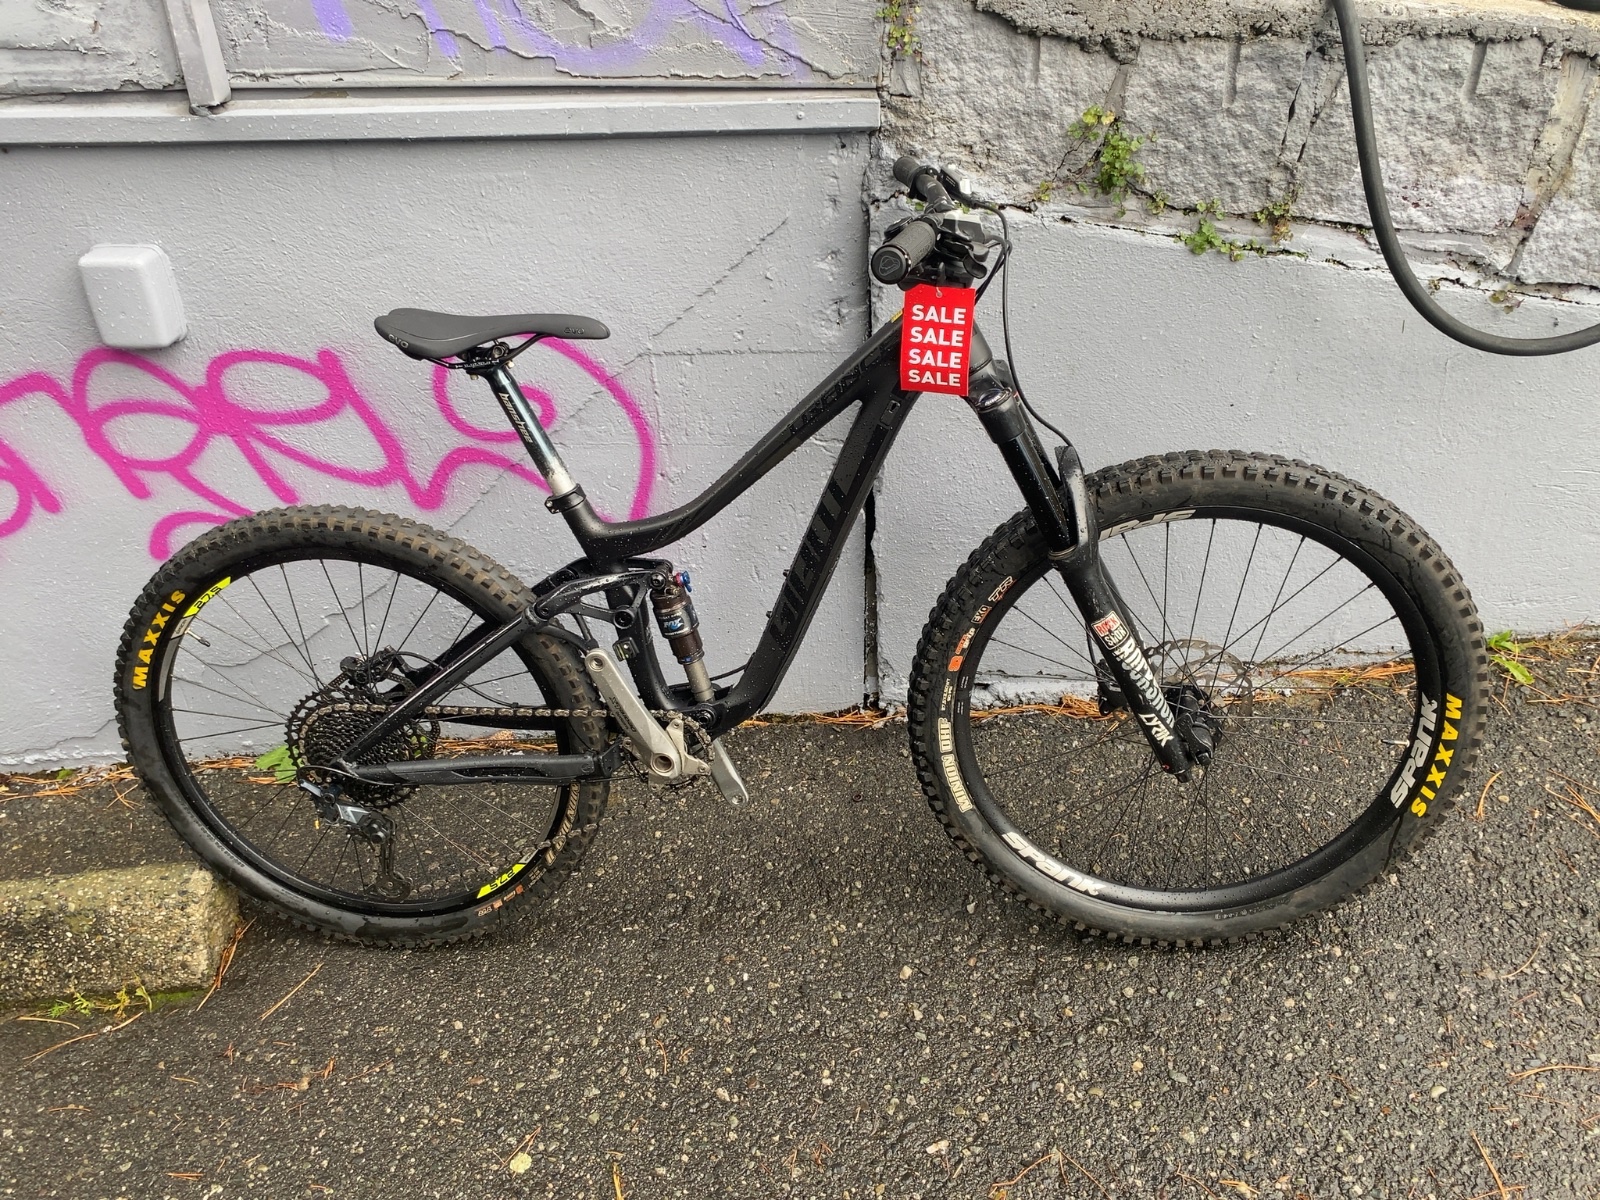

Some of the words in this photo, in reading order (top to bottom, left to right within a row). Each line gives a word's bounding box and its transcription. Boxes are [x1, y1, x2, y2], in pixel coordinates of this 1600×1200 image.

[911, 304, 966, 325] SALE
[388, 333, 409, 349] evo
[563, 326, 585, 335] evo
[909, 326, 965, 347] SALE
[908, 348, 963, 369] SALE
[908, 369, 961, 387] SALE
[498, 392, 534, 443] banshee
[194, 585, 222, 609] 27.5
[1096, 616, 1120, 635] ROCK
[1104, 626, 1128, 646] SHOX
[132, 590, 186, 689] MAXXIS
[937, 717, 953, 754] DHF
[1138, 712, 1175, 748] LYRIK
[1411, 692, 1462, 817] MAXXIS
[941, 753, 973, 813] MINION
[489, 868, 516, 890] 27.5
